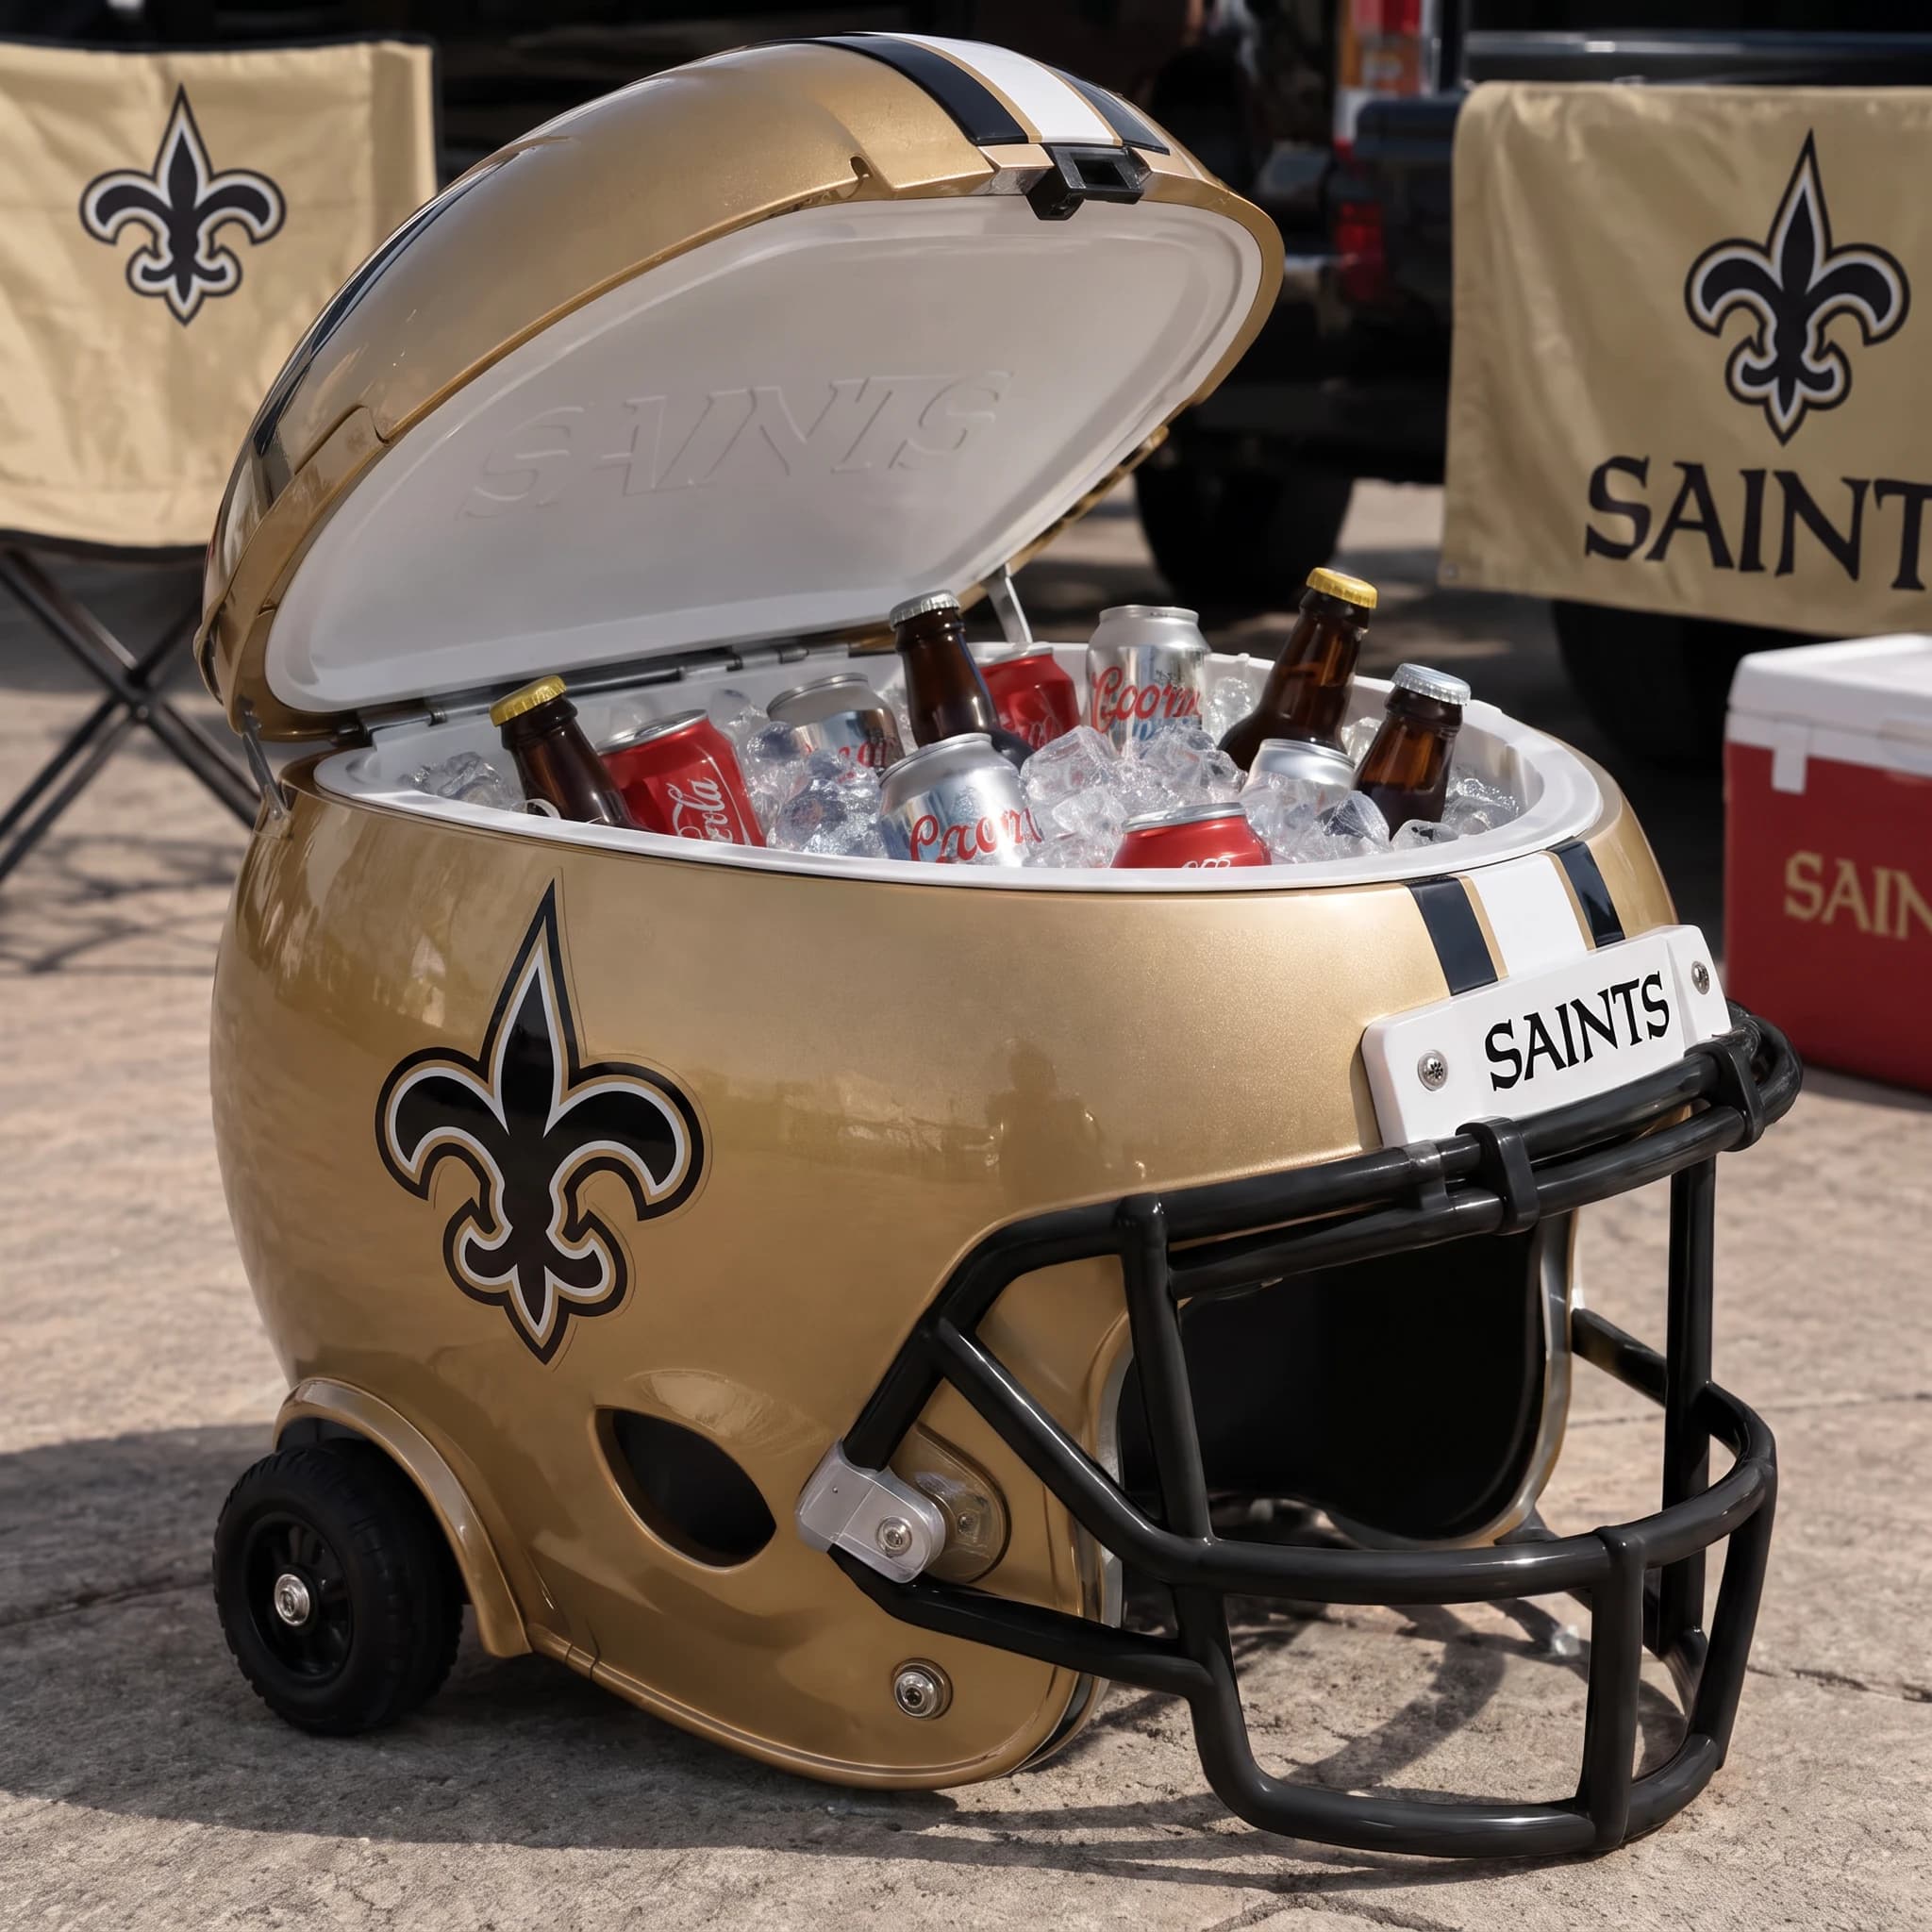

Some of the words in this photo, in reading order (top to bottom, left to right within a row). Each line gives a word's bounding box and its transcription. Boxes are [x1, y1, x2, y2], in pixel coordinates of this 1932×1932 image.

[456, 370, 1013, 519] SAINTS
[1586, 455, 1932, 591] SAINT
[1784, 850, 1932, 940] SAIN
[1485, 971, 1670, 1091] SAINTS
